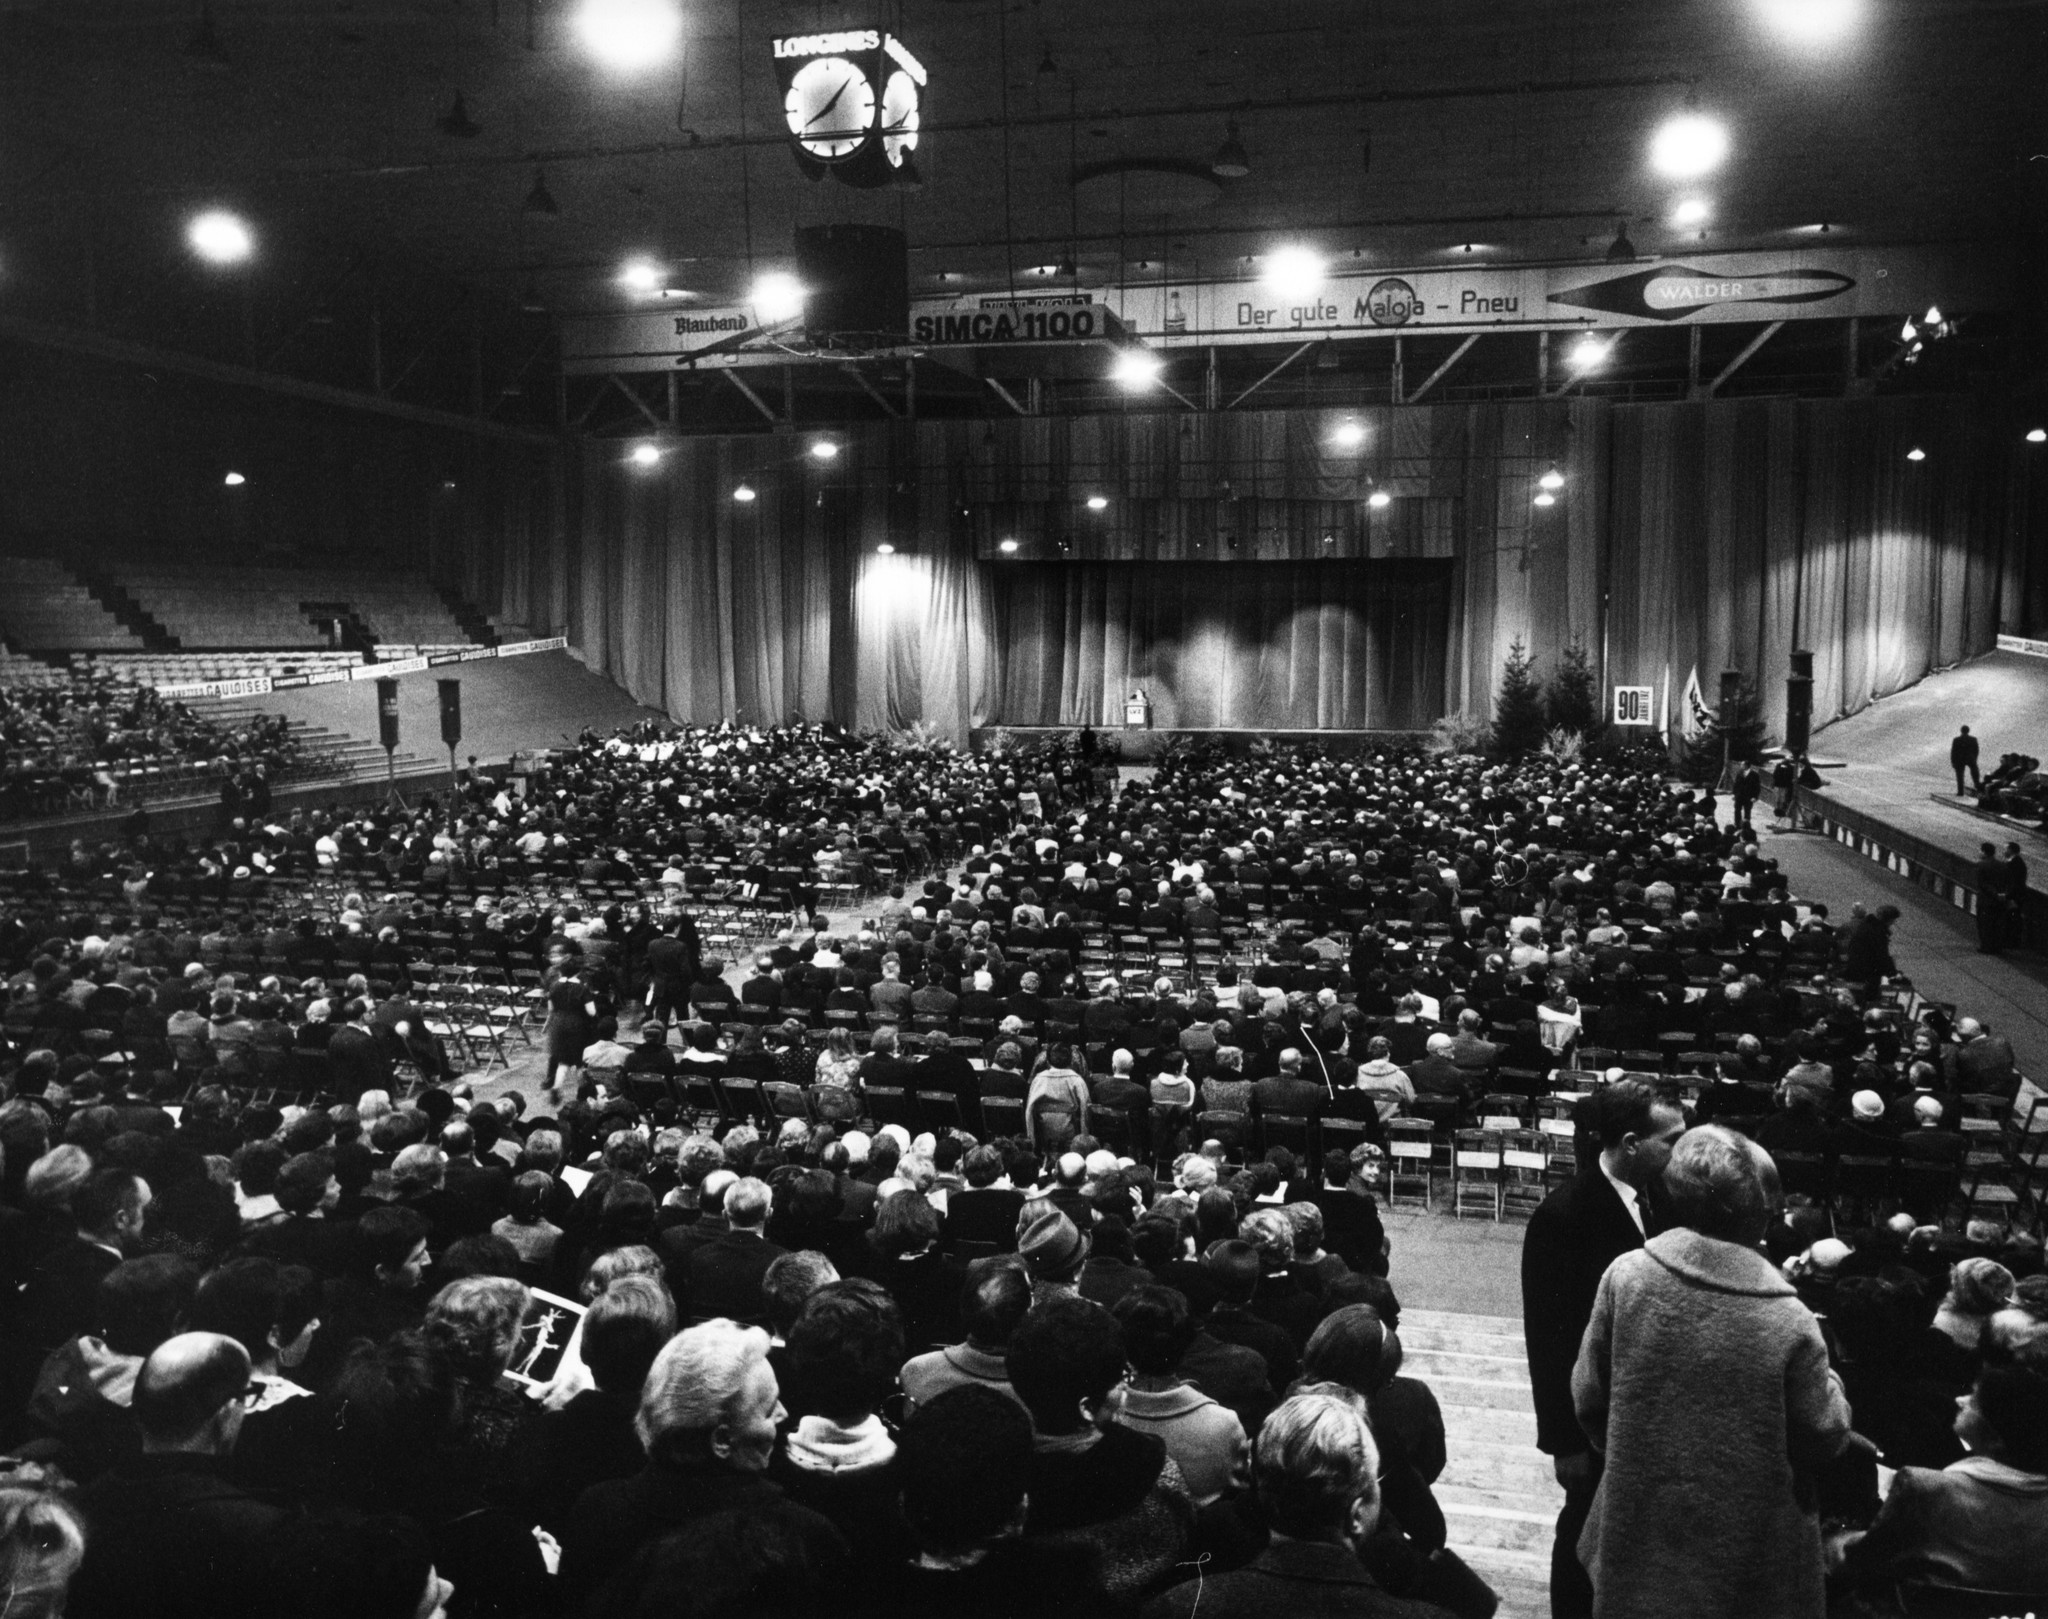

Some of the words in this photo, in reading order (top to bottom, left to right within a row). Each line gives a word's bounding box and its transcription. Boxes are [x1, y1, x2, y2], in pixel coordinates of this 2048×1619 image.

[773, 30, 880, 58] LONGINES
[1658, 282, 1743, 300] WALDER
[1237, 302, 1277, 325] Der
[1290, 299, 1338, 328] gute
[1353, 294, 1425, 320] Maloja
[1460, 290, 1519, 314] Pneu
[674, 314, 748, 335] Blauband
[914, 313, 1015, 341] SIMCA
[1023, 310, 1095, 339] 1100
[206, 679, 269, 697] GAULOISES
[1619, 691, 1638, 720] 90
